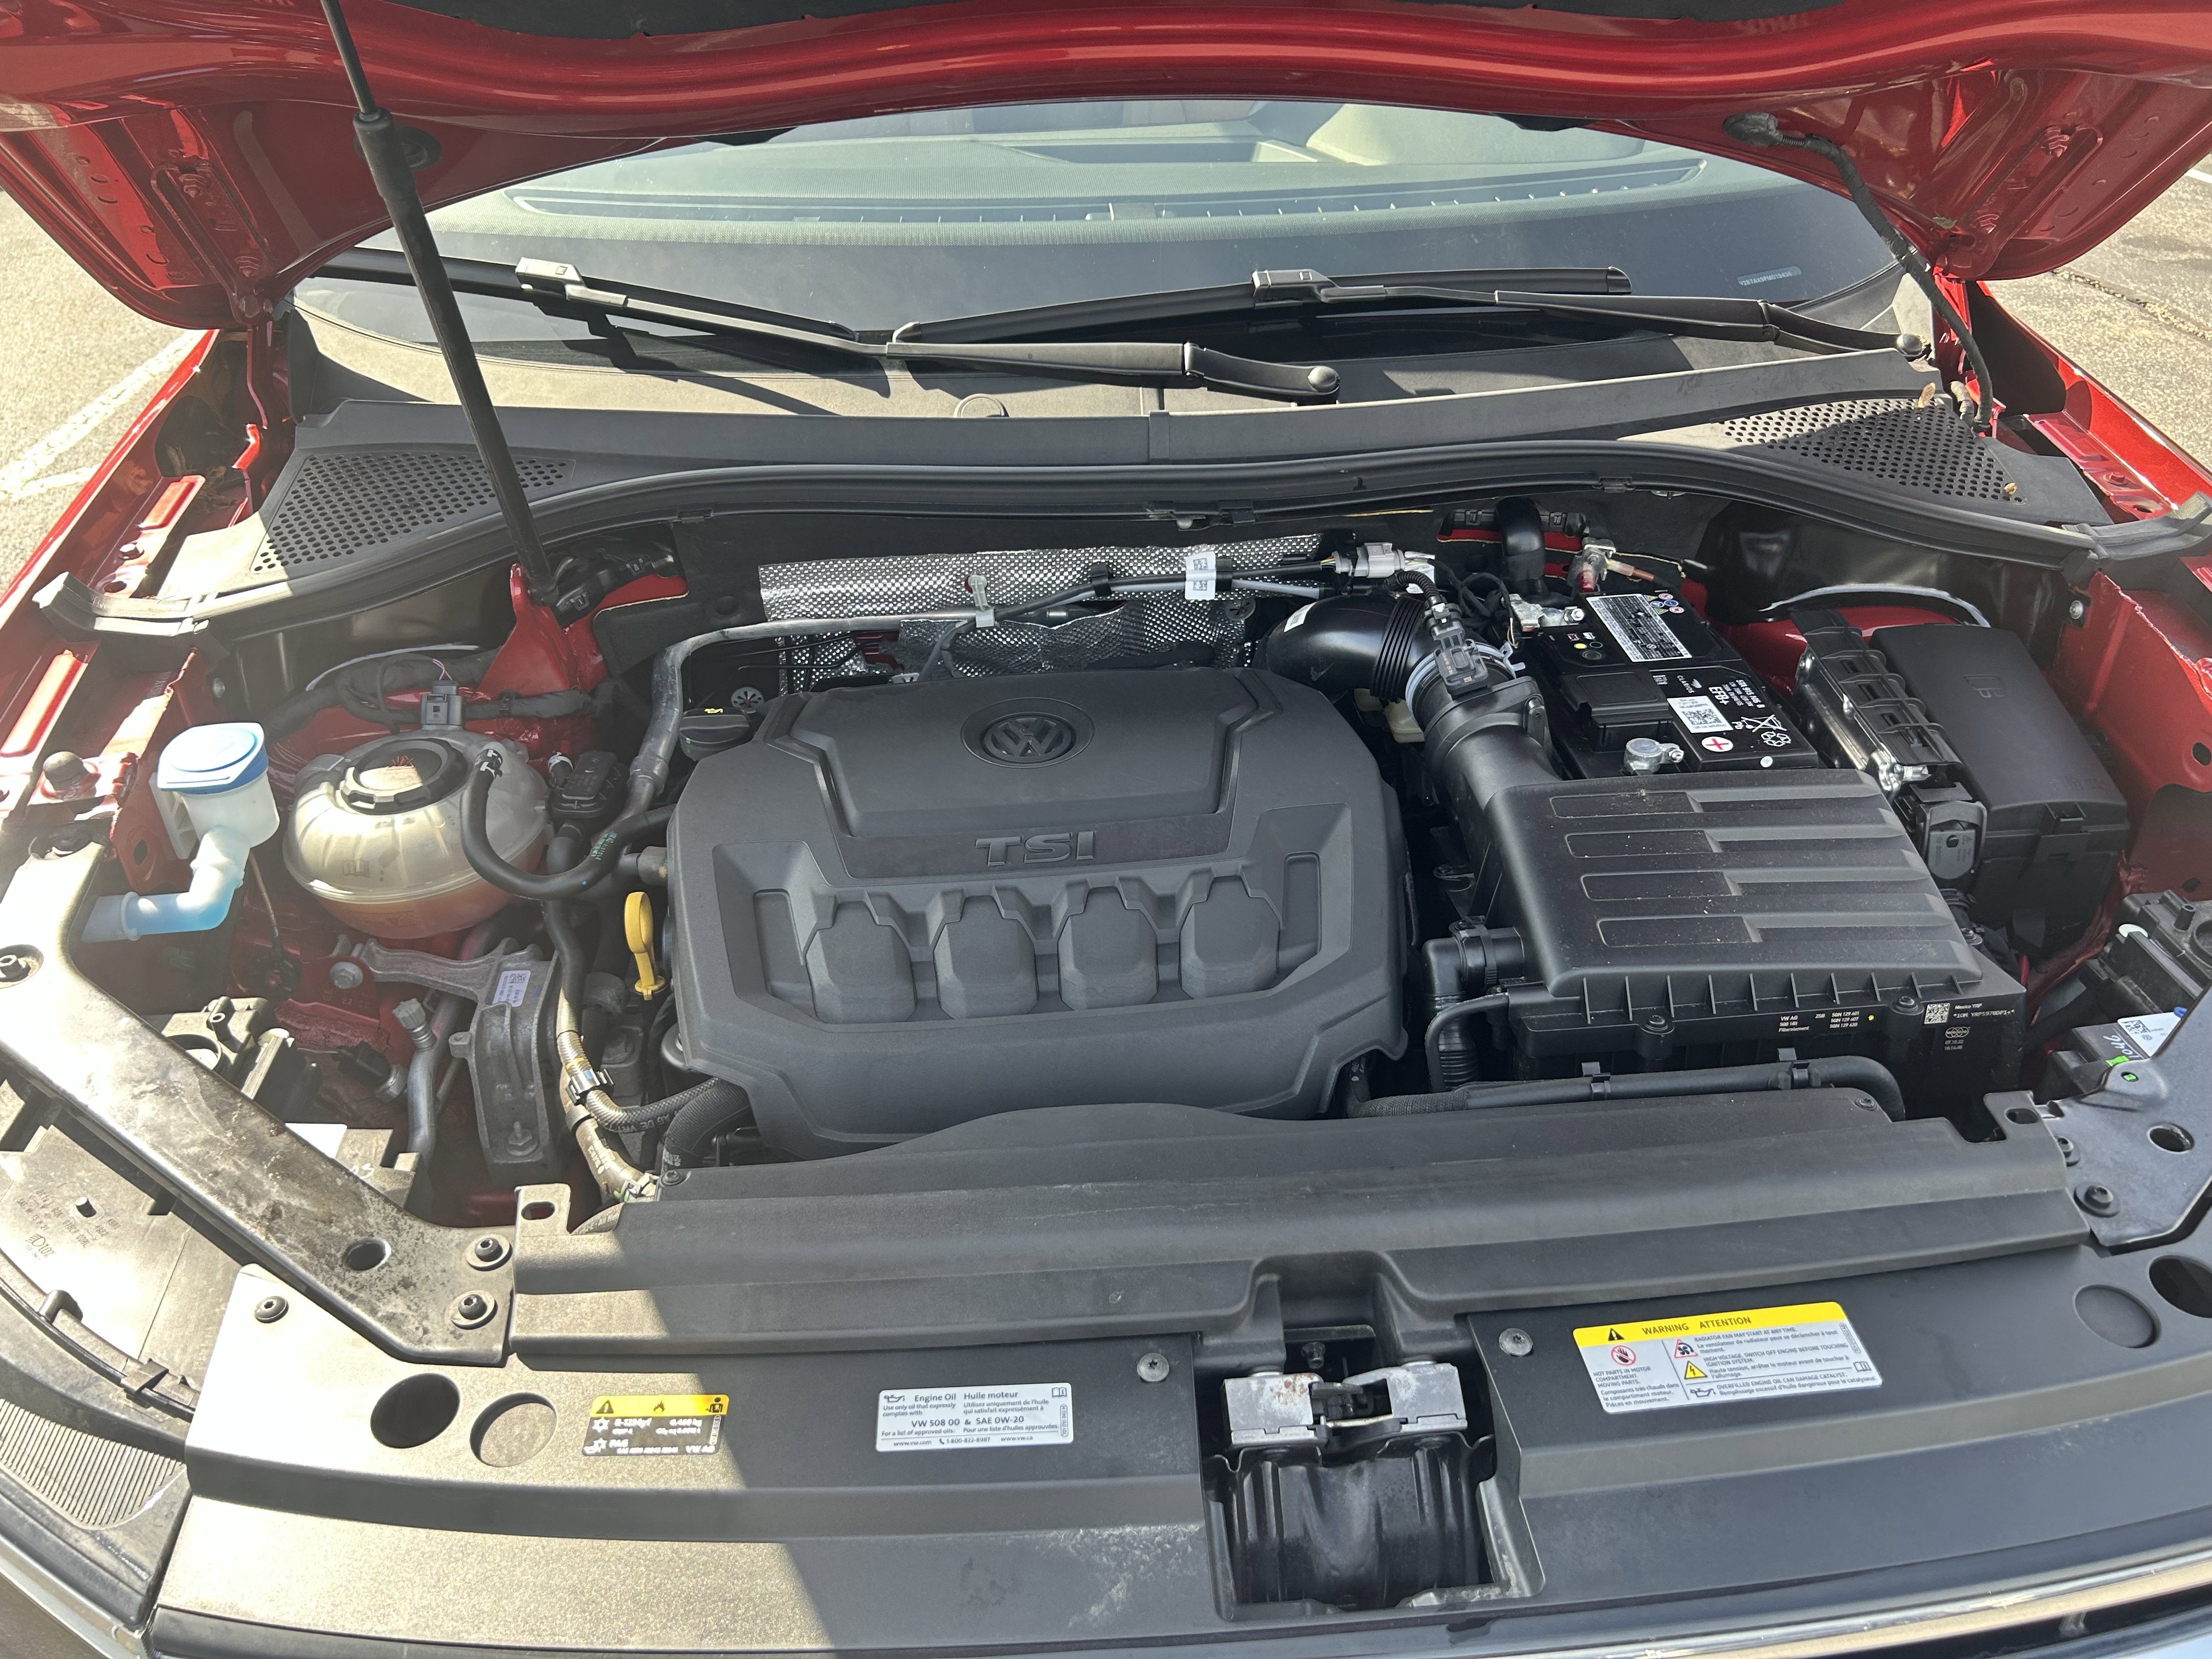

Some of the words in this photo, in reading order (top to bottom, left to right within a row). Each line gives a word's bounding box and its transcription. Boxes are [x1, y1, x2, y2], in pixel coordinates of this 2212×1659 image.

[1677, 675, 1695, 693] CLARIOS
[1708, 687, 1729, 704] EFB+
[1731, 721, 1743, 730] Pb
[974, 831, 1096, 866] TSI
[640, 1120, 654, 1130] DE
[1642, 1323, 1689, 1335] WARNING
[1700, 1317, 1751, 1328] ATTENTION
[1719, 1387, 1754, 1396] Remplissage
[915, 1395, 943, 1403] Engine
[1610, 1392, 1650, 1401] compartiment
[914, 1428, 941, 1436] approved
